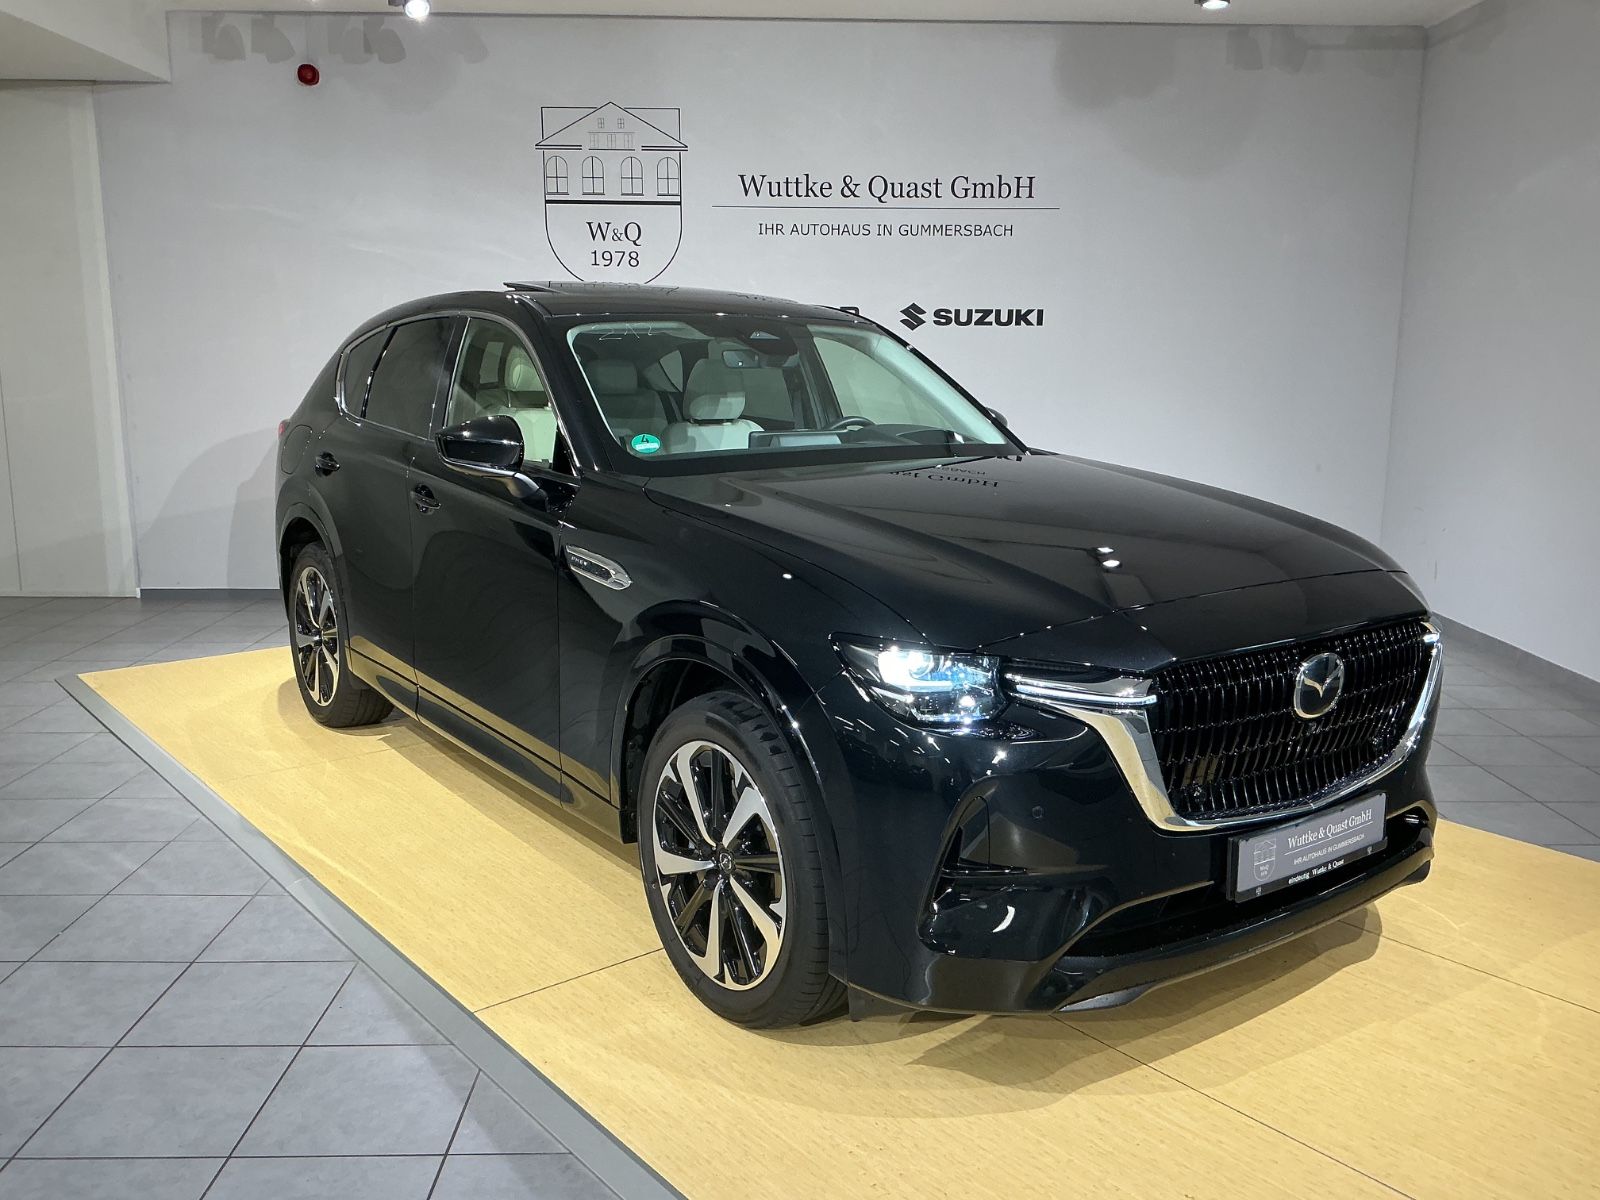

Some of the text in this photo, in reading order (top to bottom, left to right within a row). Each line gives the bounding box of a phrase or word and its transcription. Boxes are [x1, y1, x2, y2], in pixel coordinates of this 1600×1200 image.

[738, 173, 1036, 204] Wuttke & Quast GmbH
[585, 219, 643, 247] W&Q
[758, 222, 1014, 238] IHR AUTOHAUS IN GUMMERSBACH
[590, 249, 641, 269] 1978
[932, 307, 1045, 327] SUZUKI
[641, 434, 650, 444] 4
[1288, 809, 1372, 849] Wuttke & Quast GmbH
